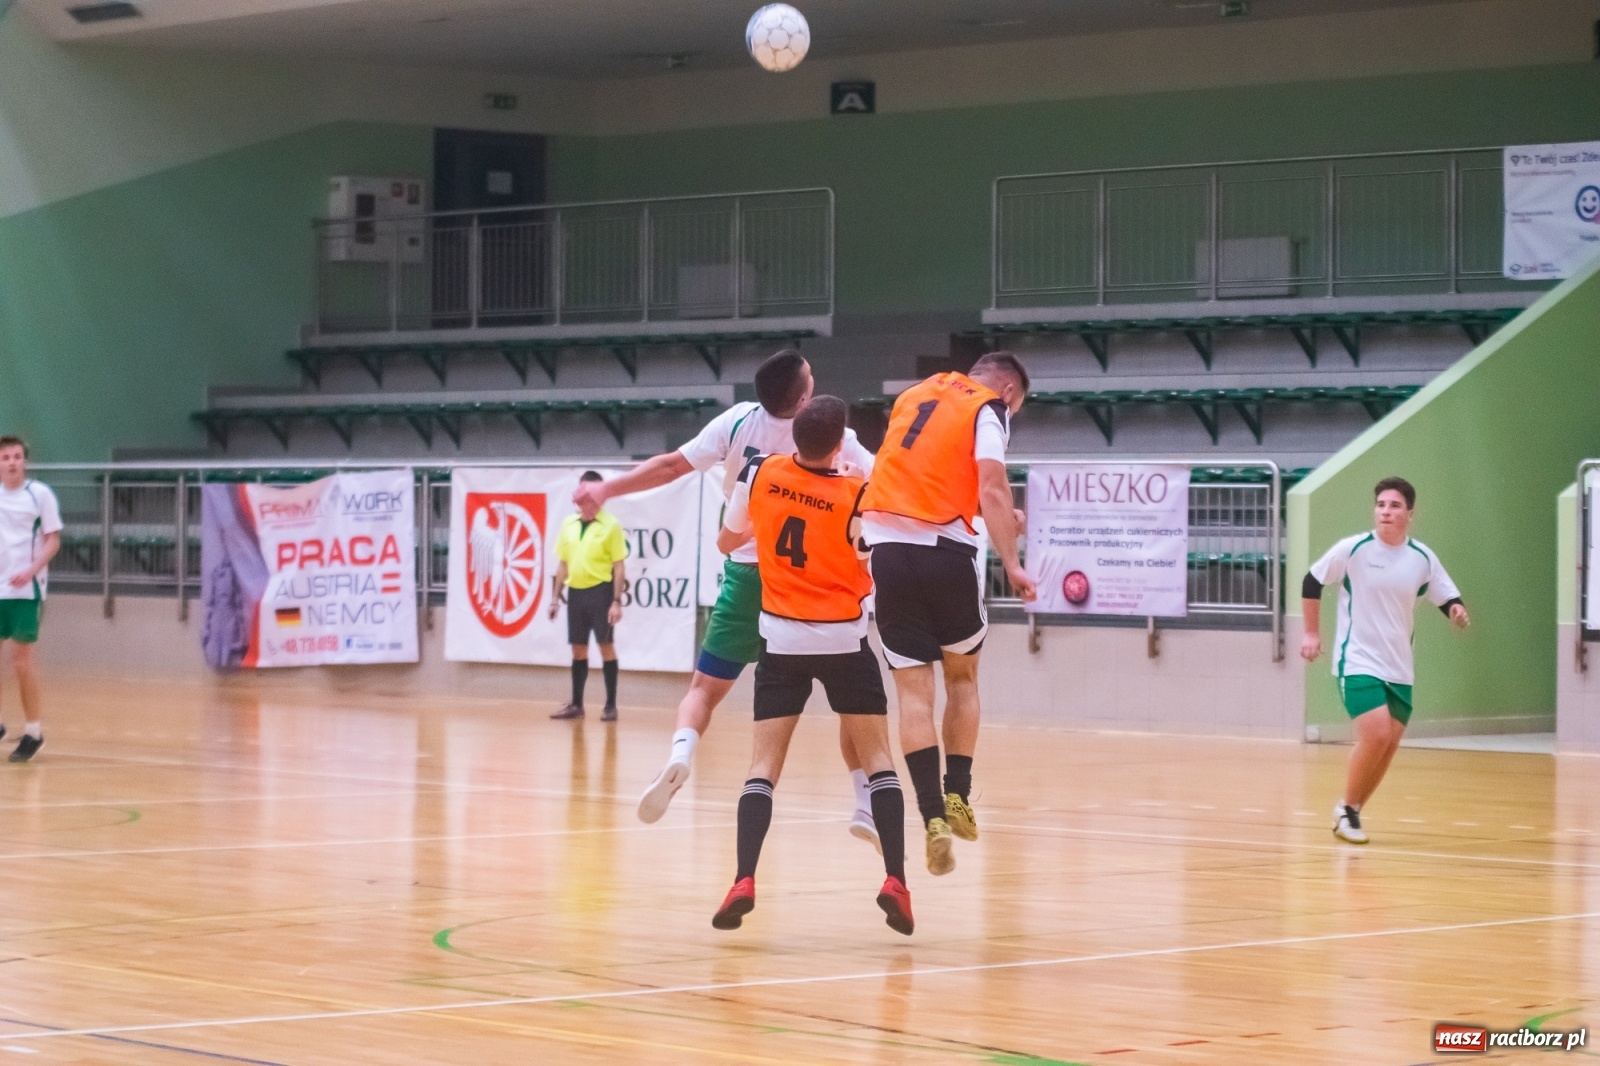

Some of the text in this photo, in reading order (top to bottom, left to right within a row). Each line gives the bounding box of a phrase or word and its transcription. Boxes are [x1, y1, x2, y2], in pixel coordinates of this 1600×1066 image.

[837, 92, 866, 110] A
[901, 399, 940, 450] 1
[343, 490, 403, 511] WORK
[1047, 472, 1168, 505] MIESZKO
[781, 489, 835, 514] PATRICK
[775, 516, 808, 569] 4
[1049, 538, 1144, 549] Pracownik produkcyjny
[1050, 526, 1086, 536] Operator
[1126, 527, 1183, 537] cukierniczych
[276, 534, 400, 571] PRACA
[1097, 558, 1176, 568] Czekamy na Ciebie!
[274, 573, 379, 600] AUSTRIA
[307, 602, 401, 626] NEMCY
